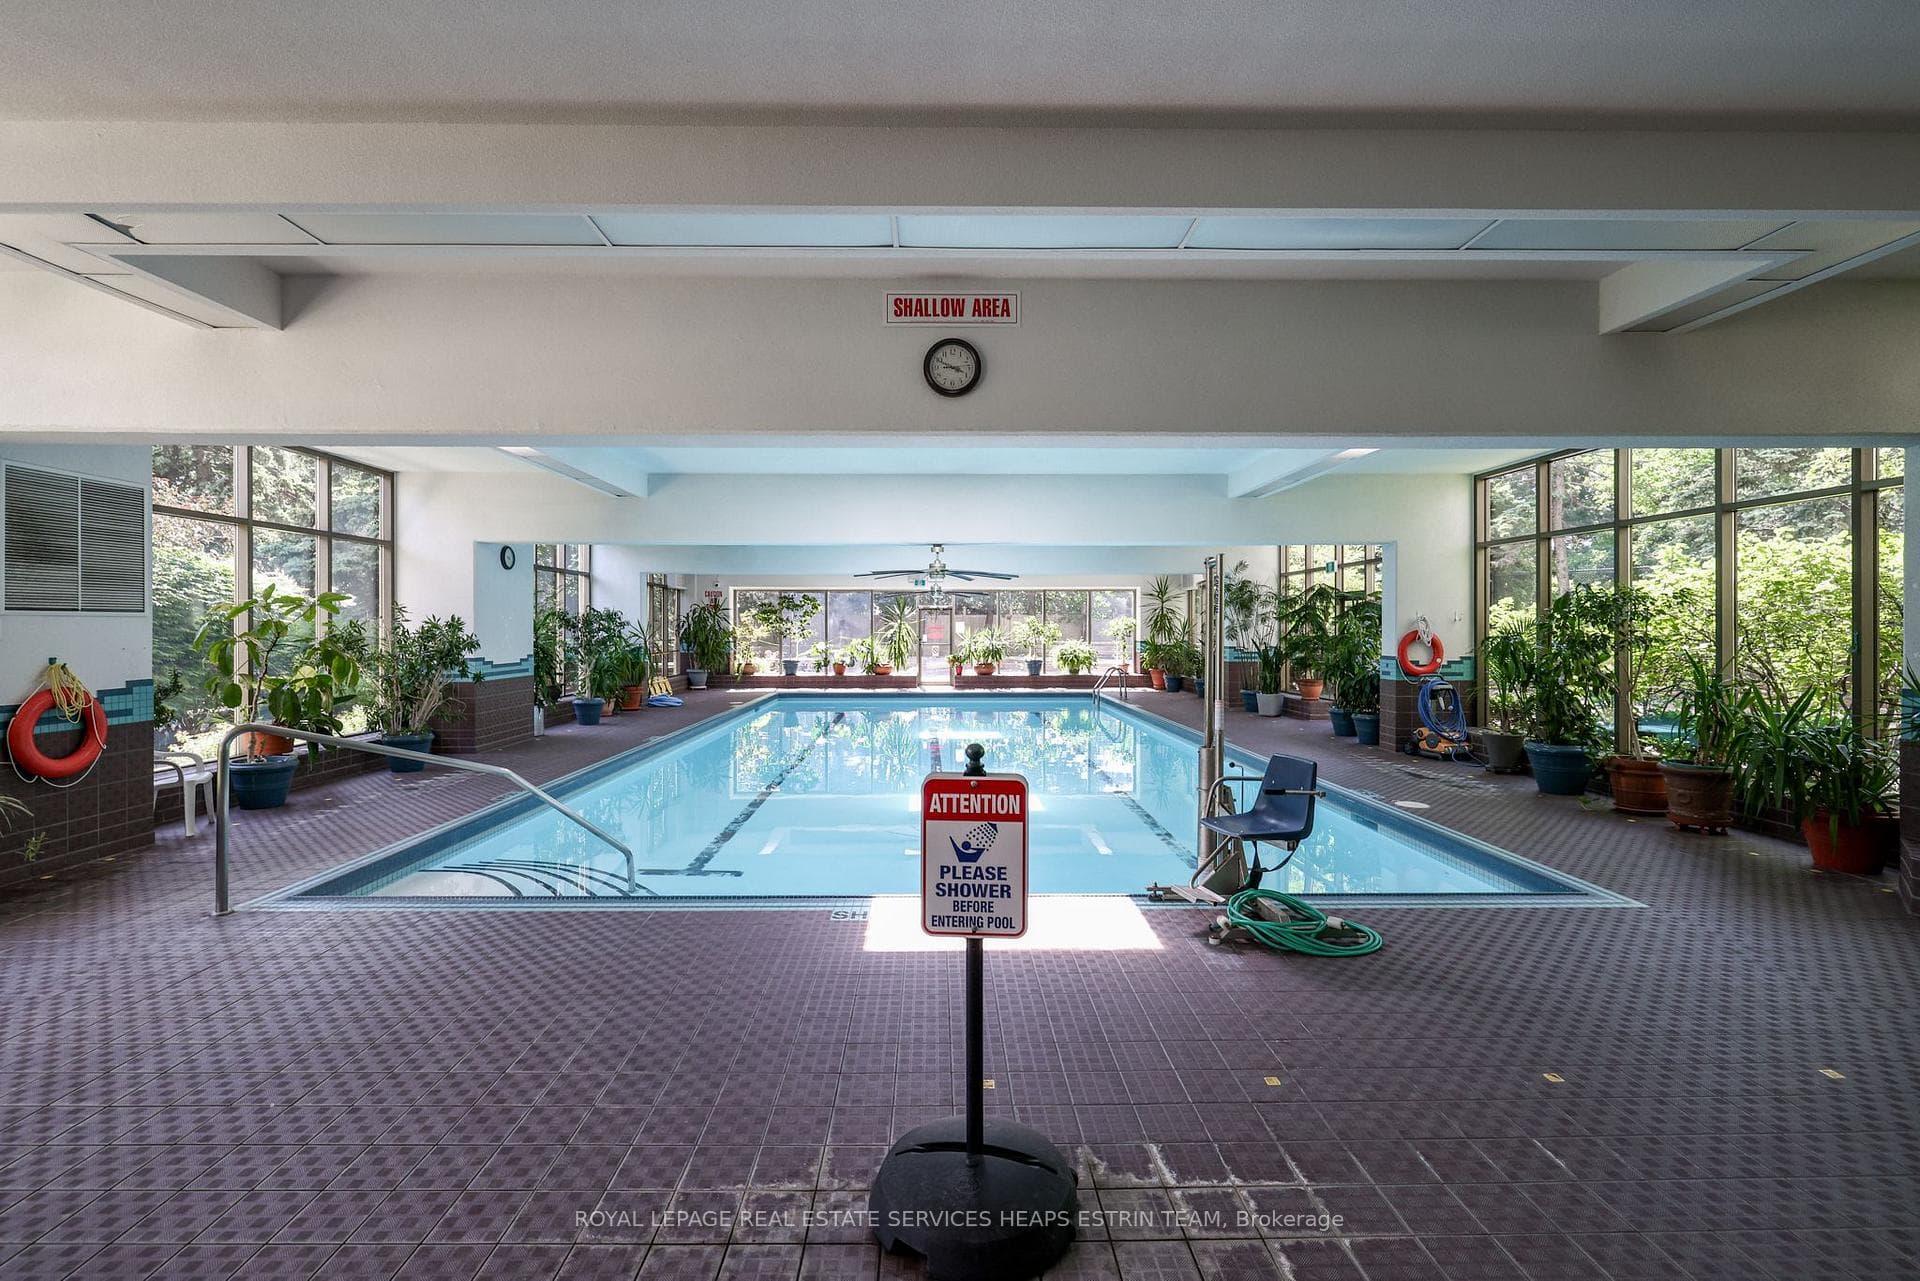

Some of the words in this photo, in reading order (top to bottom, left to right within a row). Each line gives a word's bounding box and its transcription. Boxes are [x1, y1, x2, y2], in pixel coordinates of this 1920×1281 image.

[893, 298, 966, 318] SHALLOW
[972, 298, 1011, 318] AREA
[929, 793, 1020, 815] ATTENTION
[939, 865, 1008, 881] PLEASE
[935, 882, 1012, 899] SHOWER
[952, 900, 995, 914] BEFORE
[931, 915, 984, 929] ENTERING
[987, 916, 1016, 930] POOL
